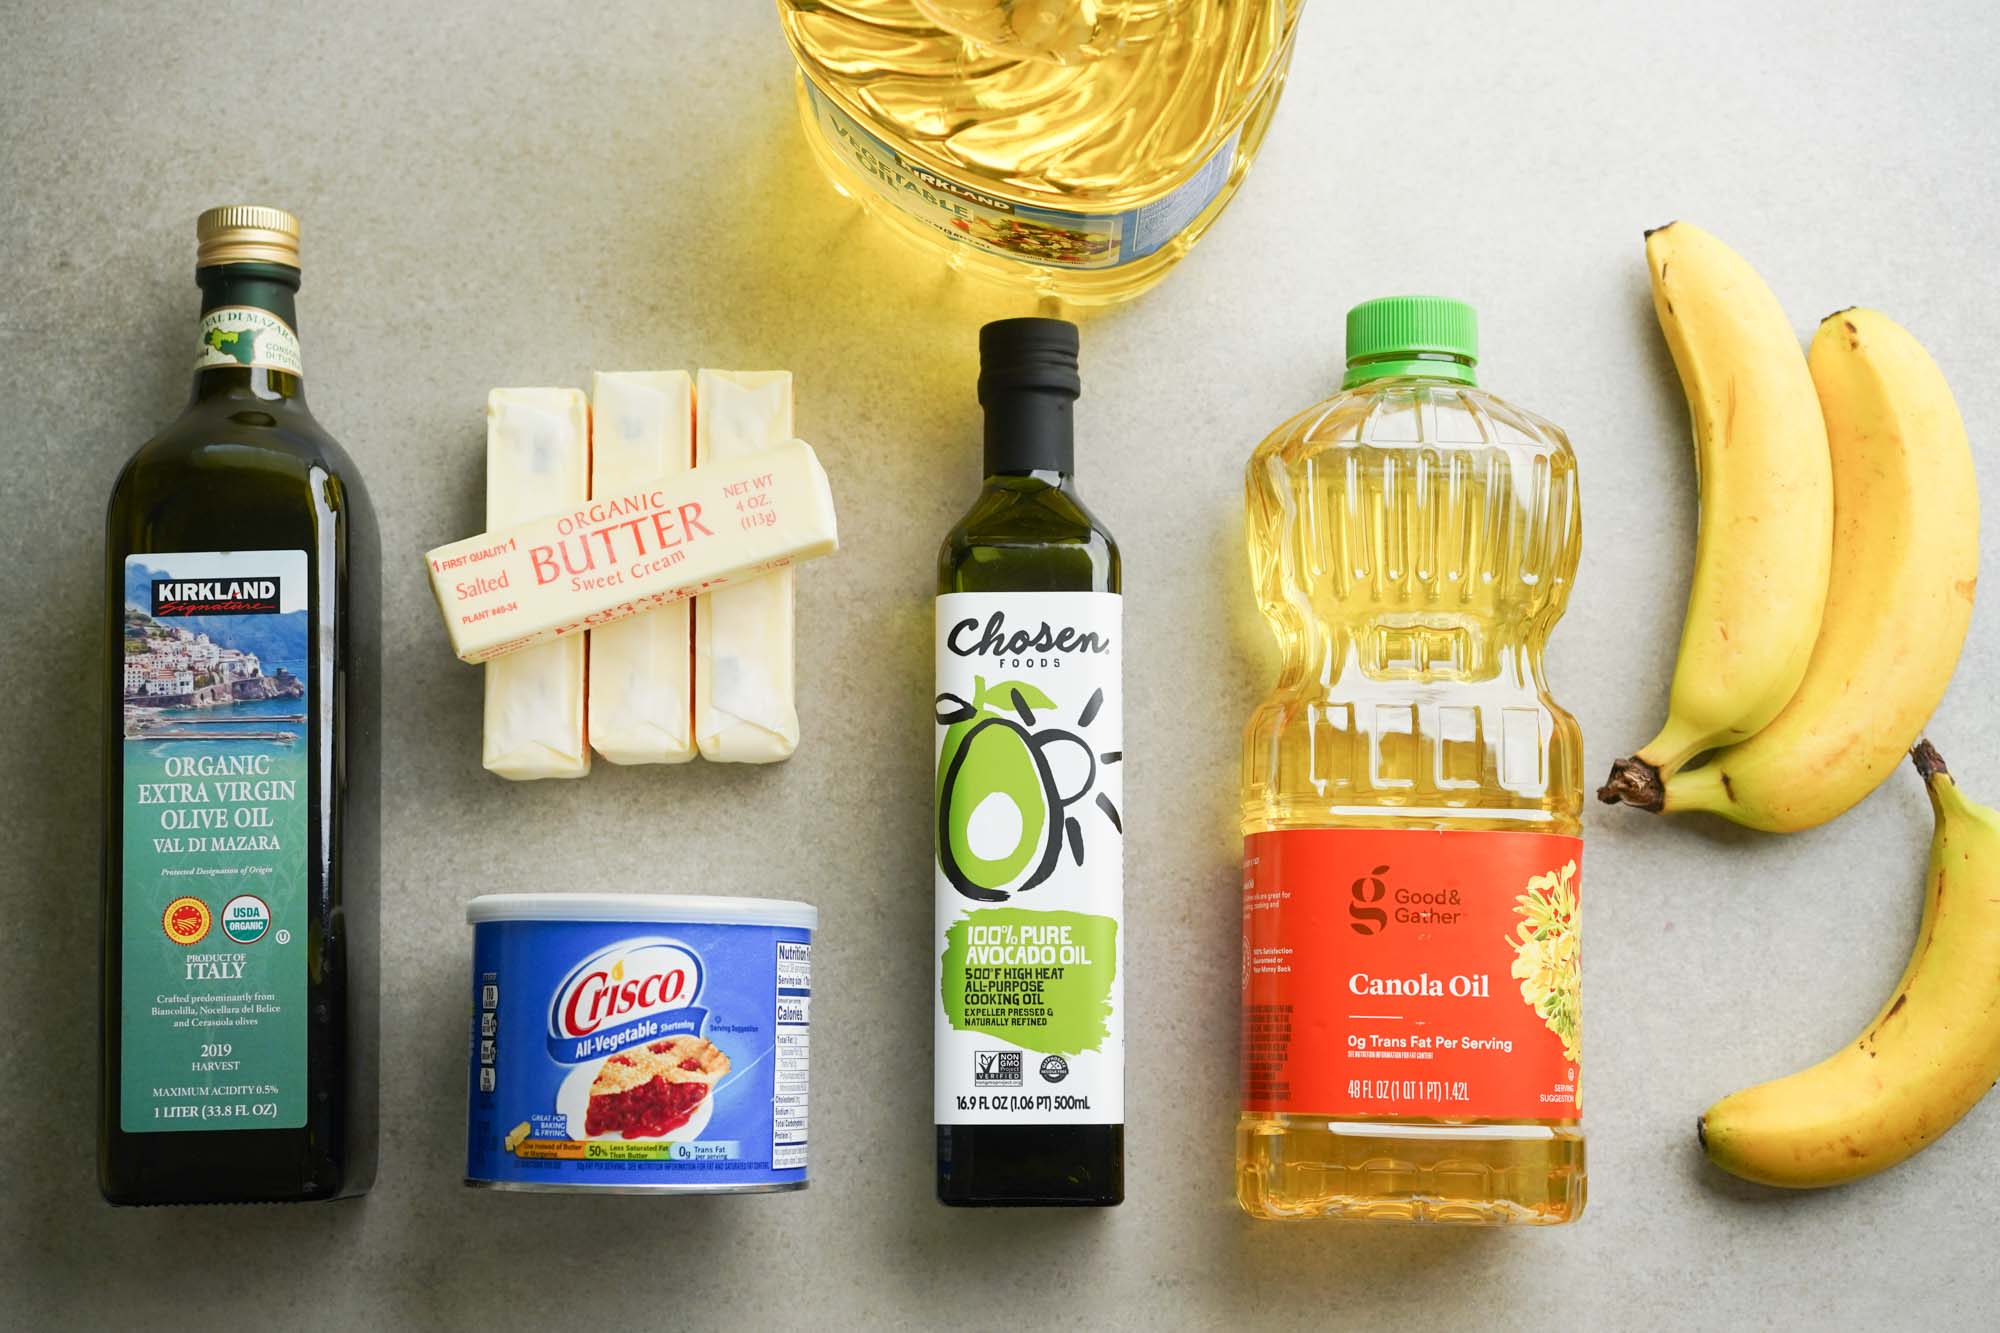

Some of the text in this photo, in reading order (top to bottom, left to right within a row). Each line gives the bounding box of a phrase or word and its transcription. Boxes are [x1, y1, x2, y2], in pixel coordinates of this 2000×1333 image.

[830, 114, 969, 220] VEGETABLE
[898, 159, 1011, 210] KIRKLAND
[723, 473, 773, 499] NET WT
[557, 491, 665, 536] ORGANIC
[735, 500, 743, 512] 4
[740, 509, 778, 531] (113g)
[528, 501, 715, 586] BUTTER
[442, 555, 468, 571] FIRST
[469, 544, 507, 563] QUALITY
[571, 549, 686, 593] Sweet Cream
[159, 581, 275, 601] KIRKLAND
[456, 569, 509, 601] Salted
[159, 601, 275, 617] Signature
[462, 610, 489, 625] PLANT
[947, 610, 1109, 657] Chosen
[999, 658, 1060, 668] FOODS
[164, 754, 270, 777] ORGANIC
[137, 780, 297, 804] EXTRA VIRGIN
[160, 807, 274, 830] OLIVE OIL
[152, 834, 281, 854] VAL DI MAZARA
[161, 866, 272, 877] Protected Designation of Origin
[233, 907, 260, 918] USDA
[1394, 907, 1461, 924] Gather
[230, 921, 263, 931] ORGANIC
[967, 925, 1072, 945] 100% PURE
[186, 953, 247, 963] PRODUCT OF
[779, 945, 806, 961] Nutrition
[965, 945, 1092, 965] AVOCADO OIL
[1263, 947, 1293, 955] Satisfaction
[185, 962, 247, 980] ITALY
[965, 968, 1064, 980] 500°F HIGH HEAT
[778, 975, 794, 986] Serving
[964, 980, 1045, 992] ALL-PURPOSE
[1348, 972, 1490, 998] Canola Oil
[156, 992, 275, 1004] Crafted predominantly from
[564, 968, 685, 1037] Crisco
[964, 993, 1044, 1006] COOKING OIL
[151, 1004, 281, 1016] Biancolilla, Nocellara del Belice
[777, 1006, 803, 1021] Calories
[964, 1008, 1053, 1017] EXPELLER PRESSED &
[174, 1017, 258, 1027] and Cerasuola olives
[964, 1017, 1047, 1026] NATURALLY REFINED
[575, 1019, 695, 1059] All-Vegetable Shortening
[1347, 1034, 1513, 1053] 0g Trans Fat Per Serving
[200, 1043, 232, 1057] 2019
[191, 1061, 241, 1071] HARVEST
[152, 1084, 279, 1097] MAXIMUM ACIDITY 0.5%
[1347, 1080, 1360, 1099] 48
[1362, 1080, 1373, 1099] FL
[1376, 1080, 1390, 1099] OZ
[1391, 1080, 1400, 1102] (1
[1403, 1080, 1416, 1100] QT
[1427, 1081, 1442, 1102] PT)
[1445, 1081, 1470, 1101] 1.42L
[154, 1102, 278, 1120] 1 LITER (33.8 FL OZ)
[956, 1095, 1090, 1112] 16.9 FL OZ (1.06 PT) 500mL
[540, 1122, 566, 1130] BAKING
[541, 1129, 566, 1137] FRYING
[589, 1145, 608, 1158] 50%
[678, 1145, 691, 1159] 0g
[694, 1146, 713, 1154] Trans
